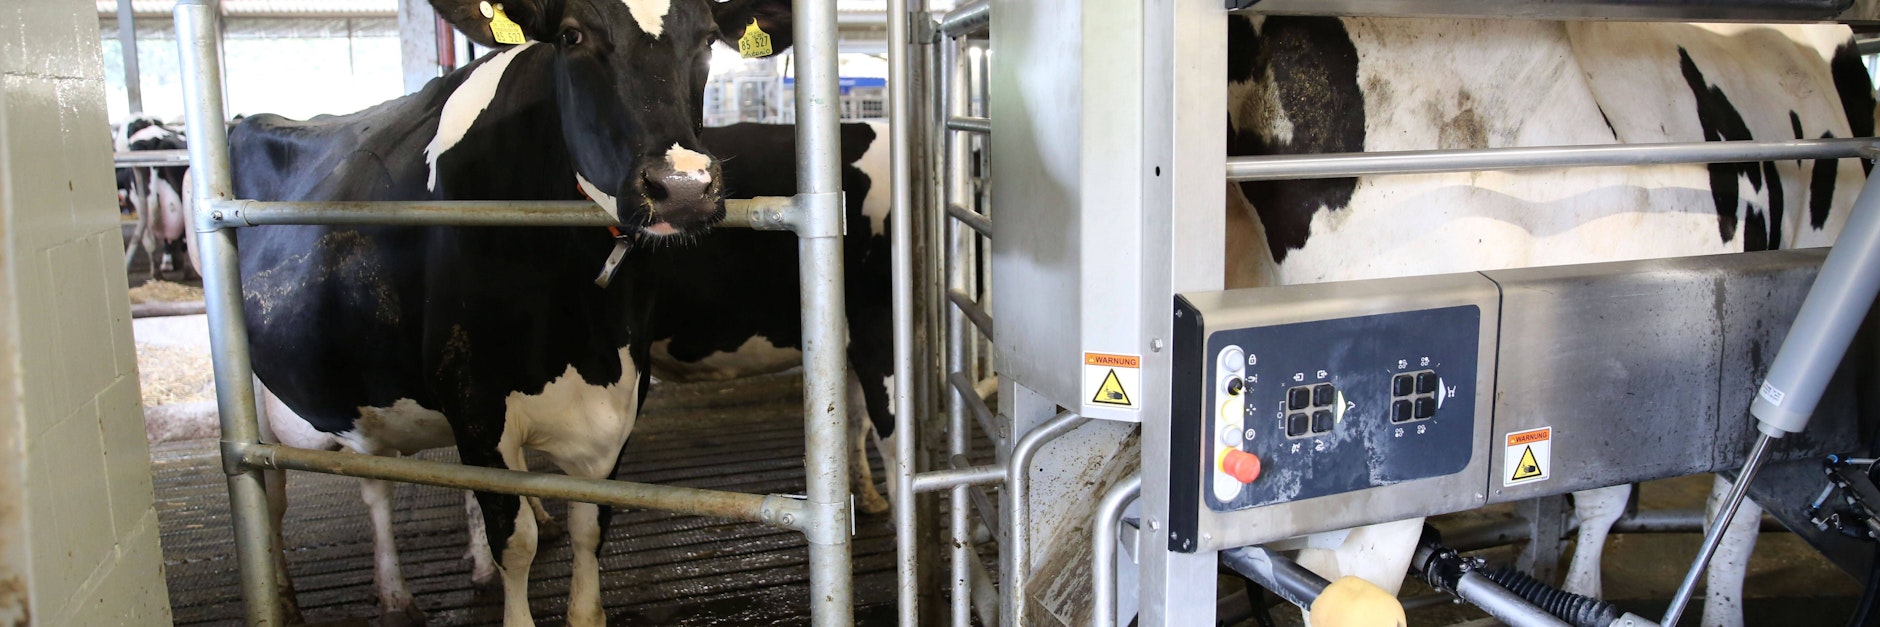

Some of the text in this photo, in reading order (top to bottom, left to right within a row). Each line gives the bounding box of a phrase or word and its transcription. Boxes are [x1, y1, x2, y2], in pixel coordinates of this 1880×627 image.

[741, 35, 768, 51] 85 527
[1095, 356, 1137, 366] WARNUNG
[1515, 431, 1548, 443] WARNUNG
